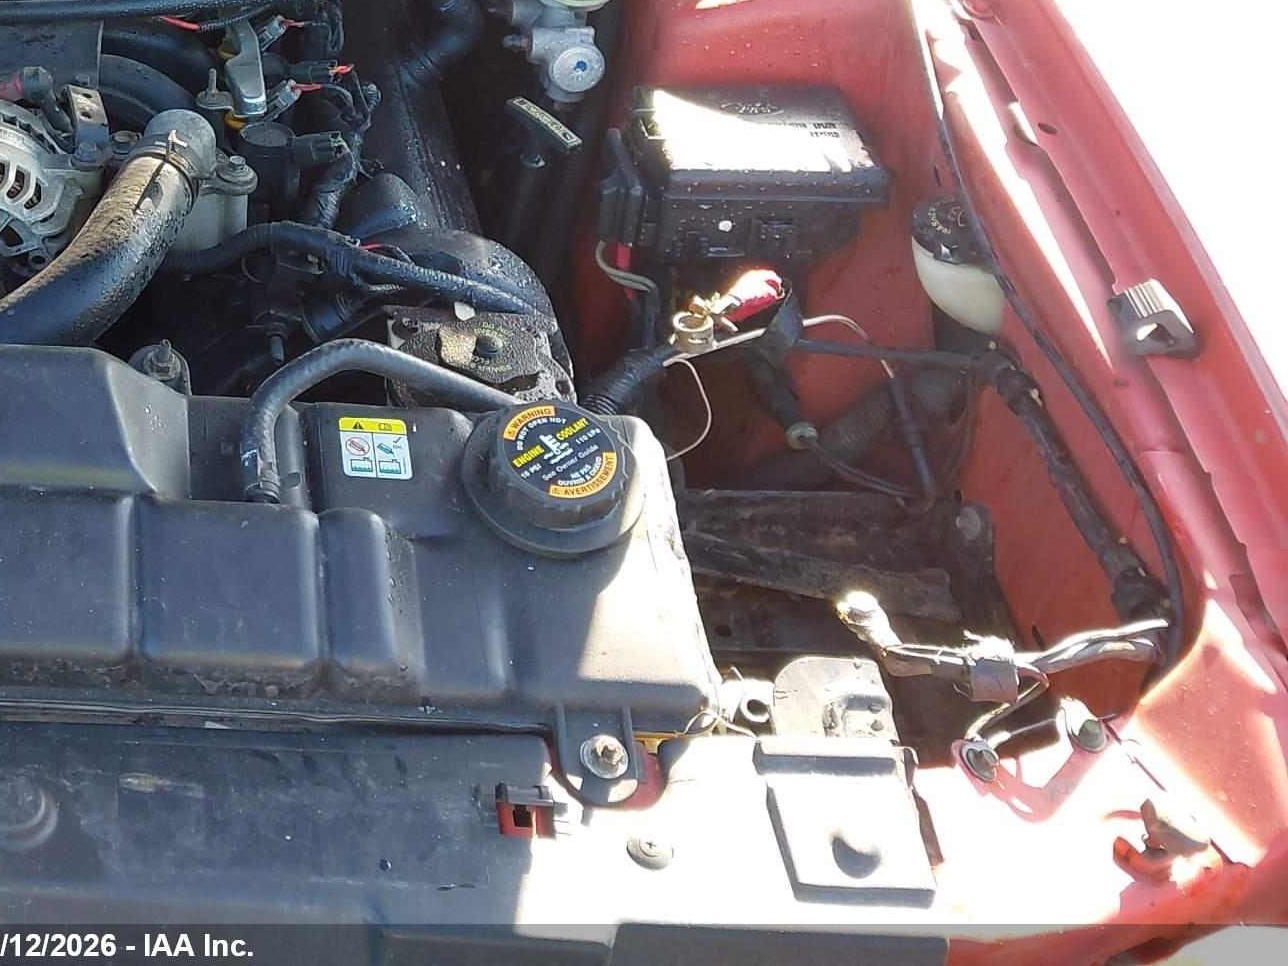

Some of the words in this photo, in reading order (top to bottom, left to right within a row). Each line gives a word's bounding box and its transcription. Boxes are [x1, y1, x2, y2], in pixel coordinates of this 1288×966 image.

[511, 408, 552, 430] WARNING
[528, 417, 548, 429] OPEN
[518, 428, 529, 442] NOT
[555, 417, 591, 441] COOLANT
[516, 440, 525, 451] DO
[575, 435, 588, 446] 110
[512, 445, 546, 468] ENGINE
[542, 469, 557, 482] See
[556, 456, 579, 473] Owner
[577, 444, 600, 460] Guide
[529, 463, 543, 475] PSI
[580, 464, 592, 476] PAS
[558, 477, 586, 486] OUVRIR
[563, 455, 615, 497] AVERTISSEMENT
